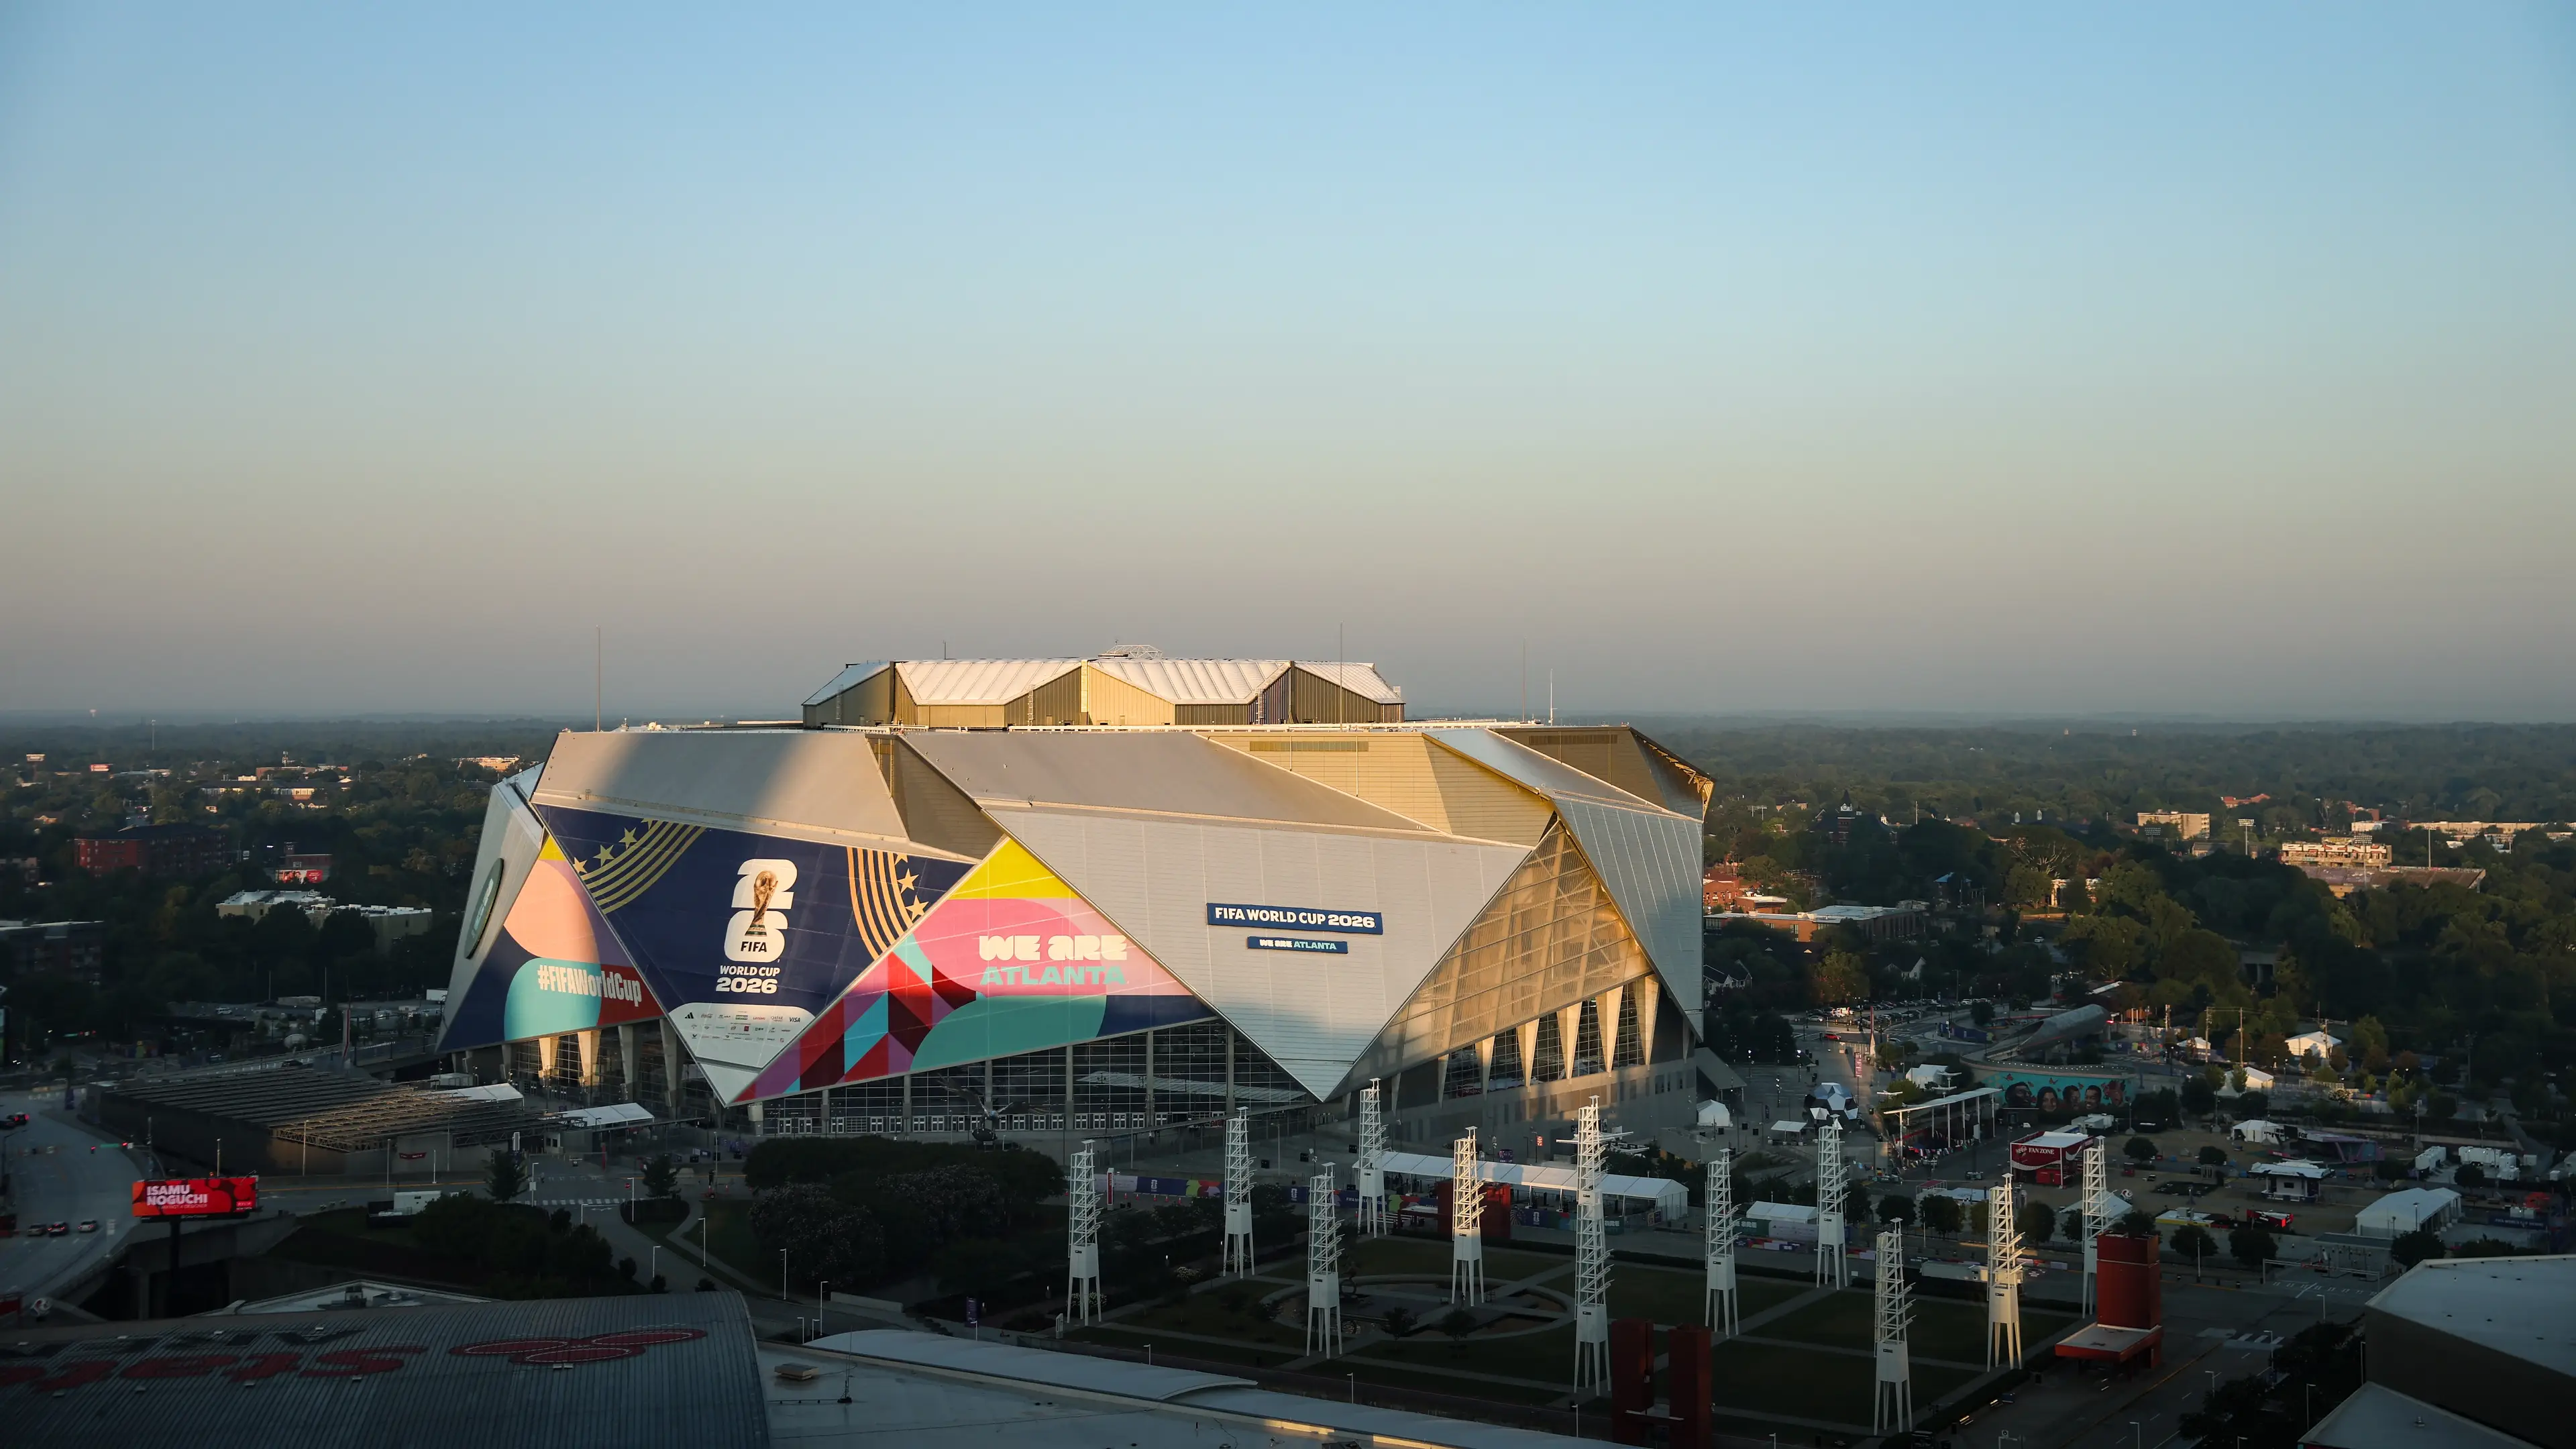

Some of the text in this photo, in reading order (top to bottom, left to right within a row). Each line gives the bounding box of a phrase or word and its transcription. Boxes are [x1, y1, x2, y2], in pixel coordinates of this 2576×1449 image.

[1215, 907, 1375, 928] FIFA WORLD CUP 2026
[741, 941, 767, 953] FIFA
[979, 935, 1127, 961] WE ARE
[1259, 939, 1336, 950] WE ARE ATLANTA
[720, 965, 780, 977] WORLD CUP
[980, 966, 1127, 985] ATLANTA
[537, 965, 642, 1007] #FIFAWorldCup
[716, 977, 777, 994] 2026
[147, 1185, 190, 1195] ISAMU
[147, 1194, 208, 1205] NOGUCHI
